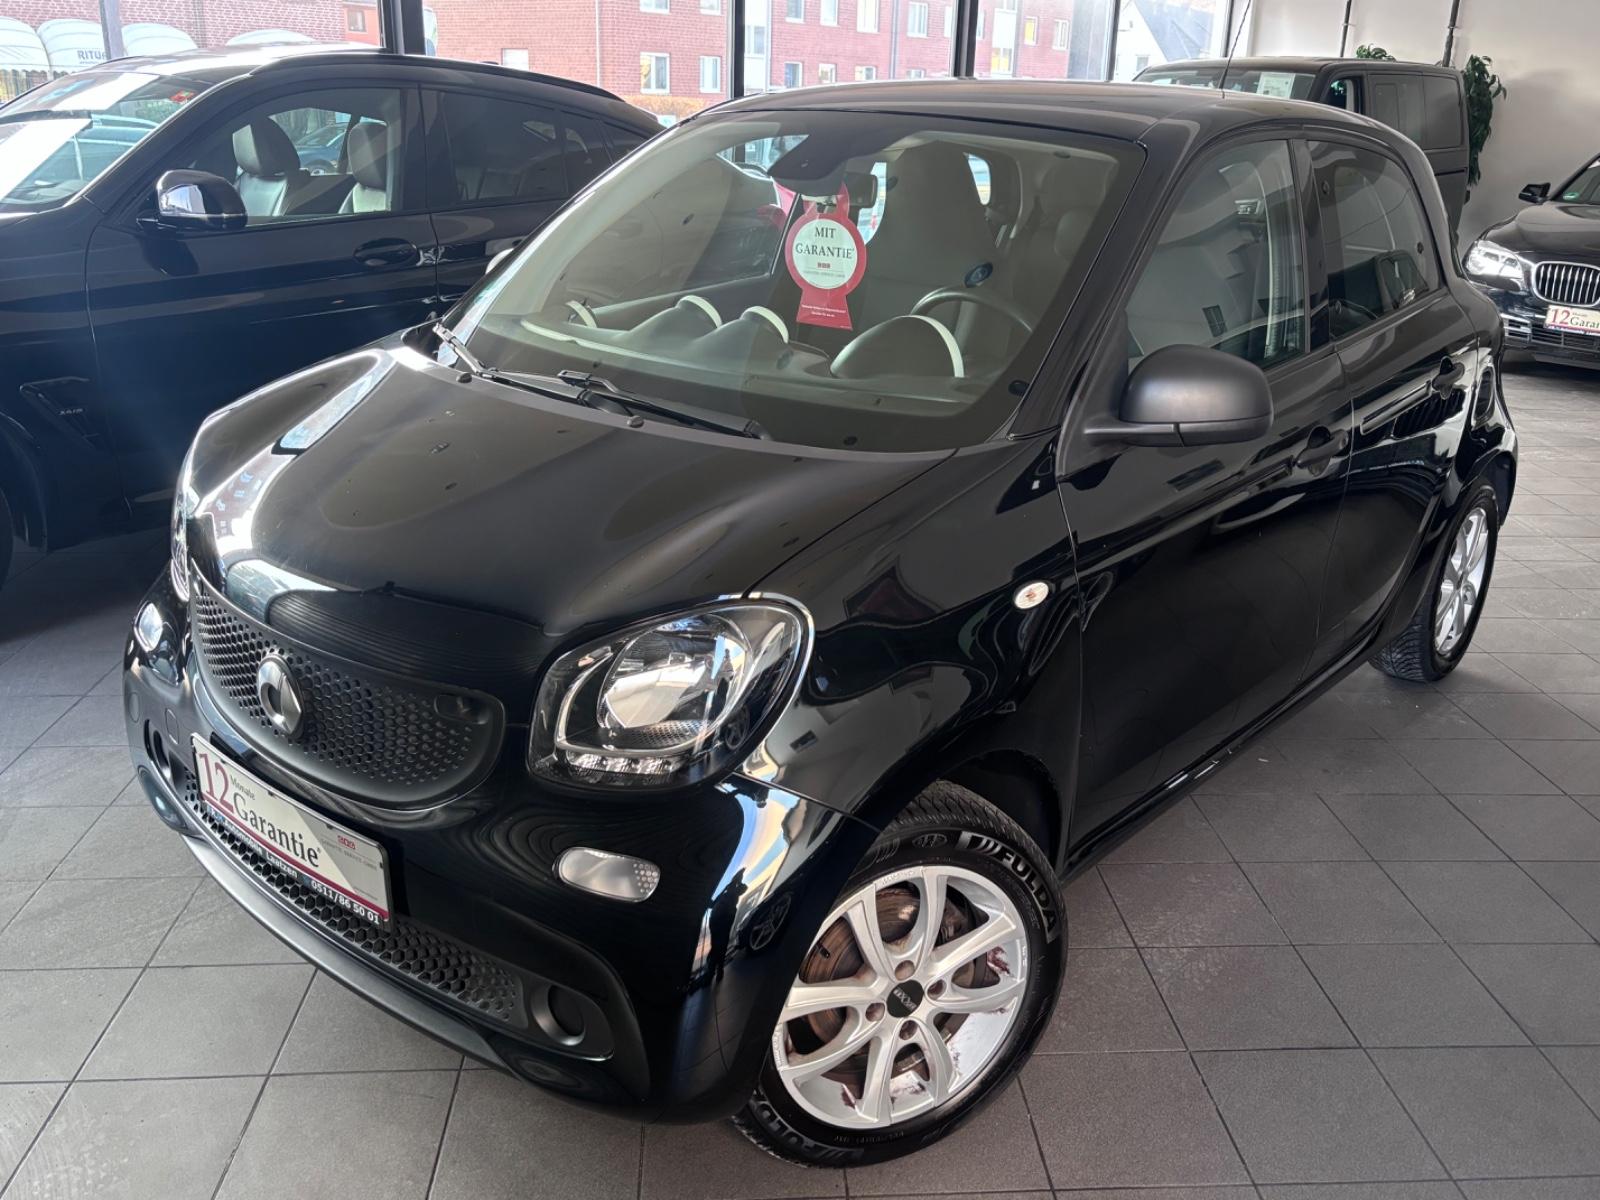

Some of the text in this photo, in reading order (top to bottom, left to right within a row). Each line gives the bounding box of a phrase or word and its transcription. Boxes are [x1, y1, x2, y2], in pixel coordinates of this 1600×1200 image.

[795, 242, 854, 259] GARANTIE
[814, 226, 836, 239] MIT
[1552, 308, 1571, 325] 12
[199, 753, 235, 814] 12
[233, 791, 320, 867] Garantie
[266, 851, 299, 879] Laatzen
[352, 902, 366, 917] 50
[366, 909, 380, 925] 01
[995, 845, 1057, 933] FULDA
